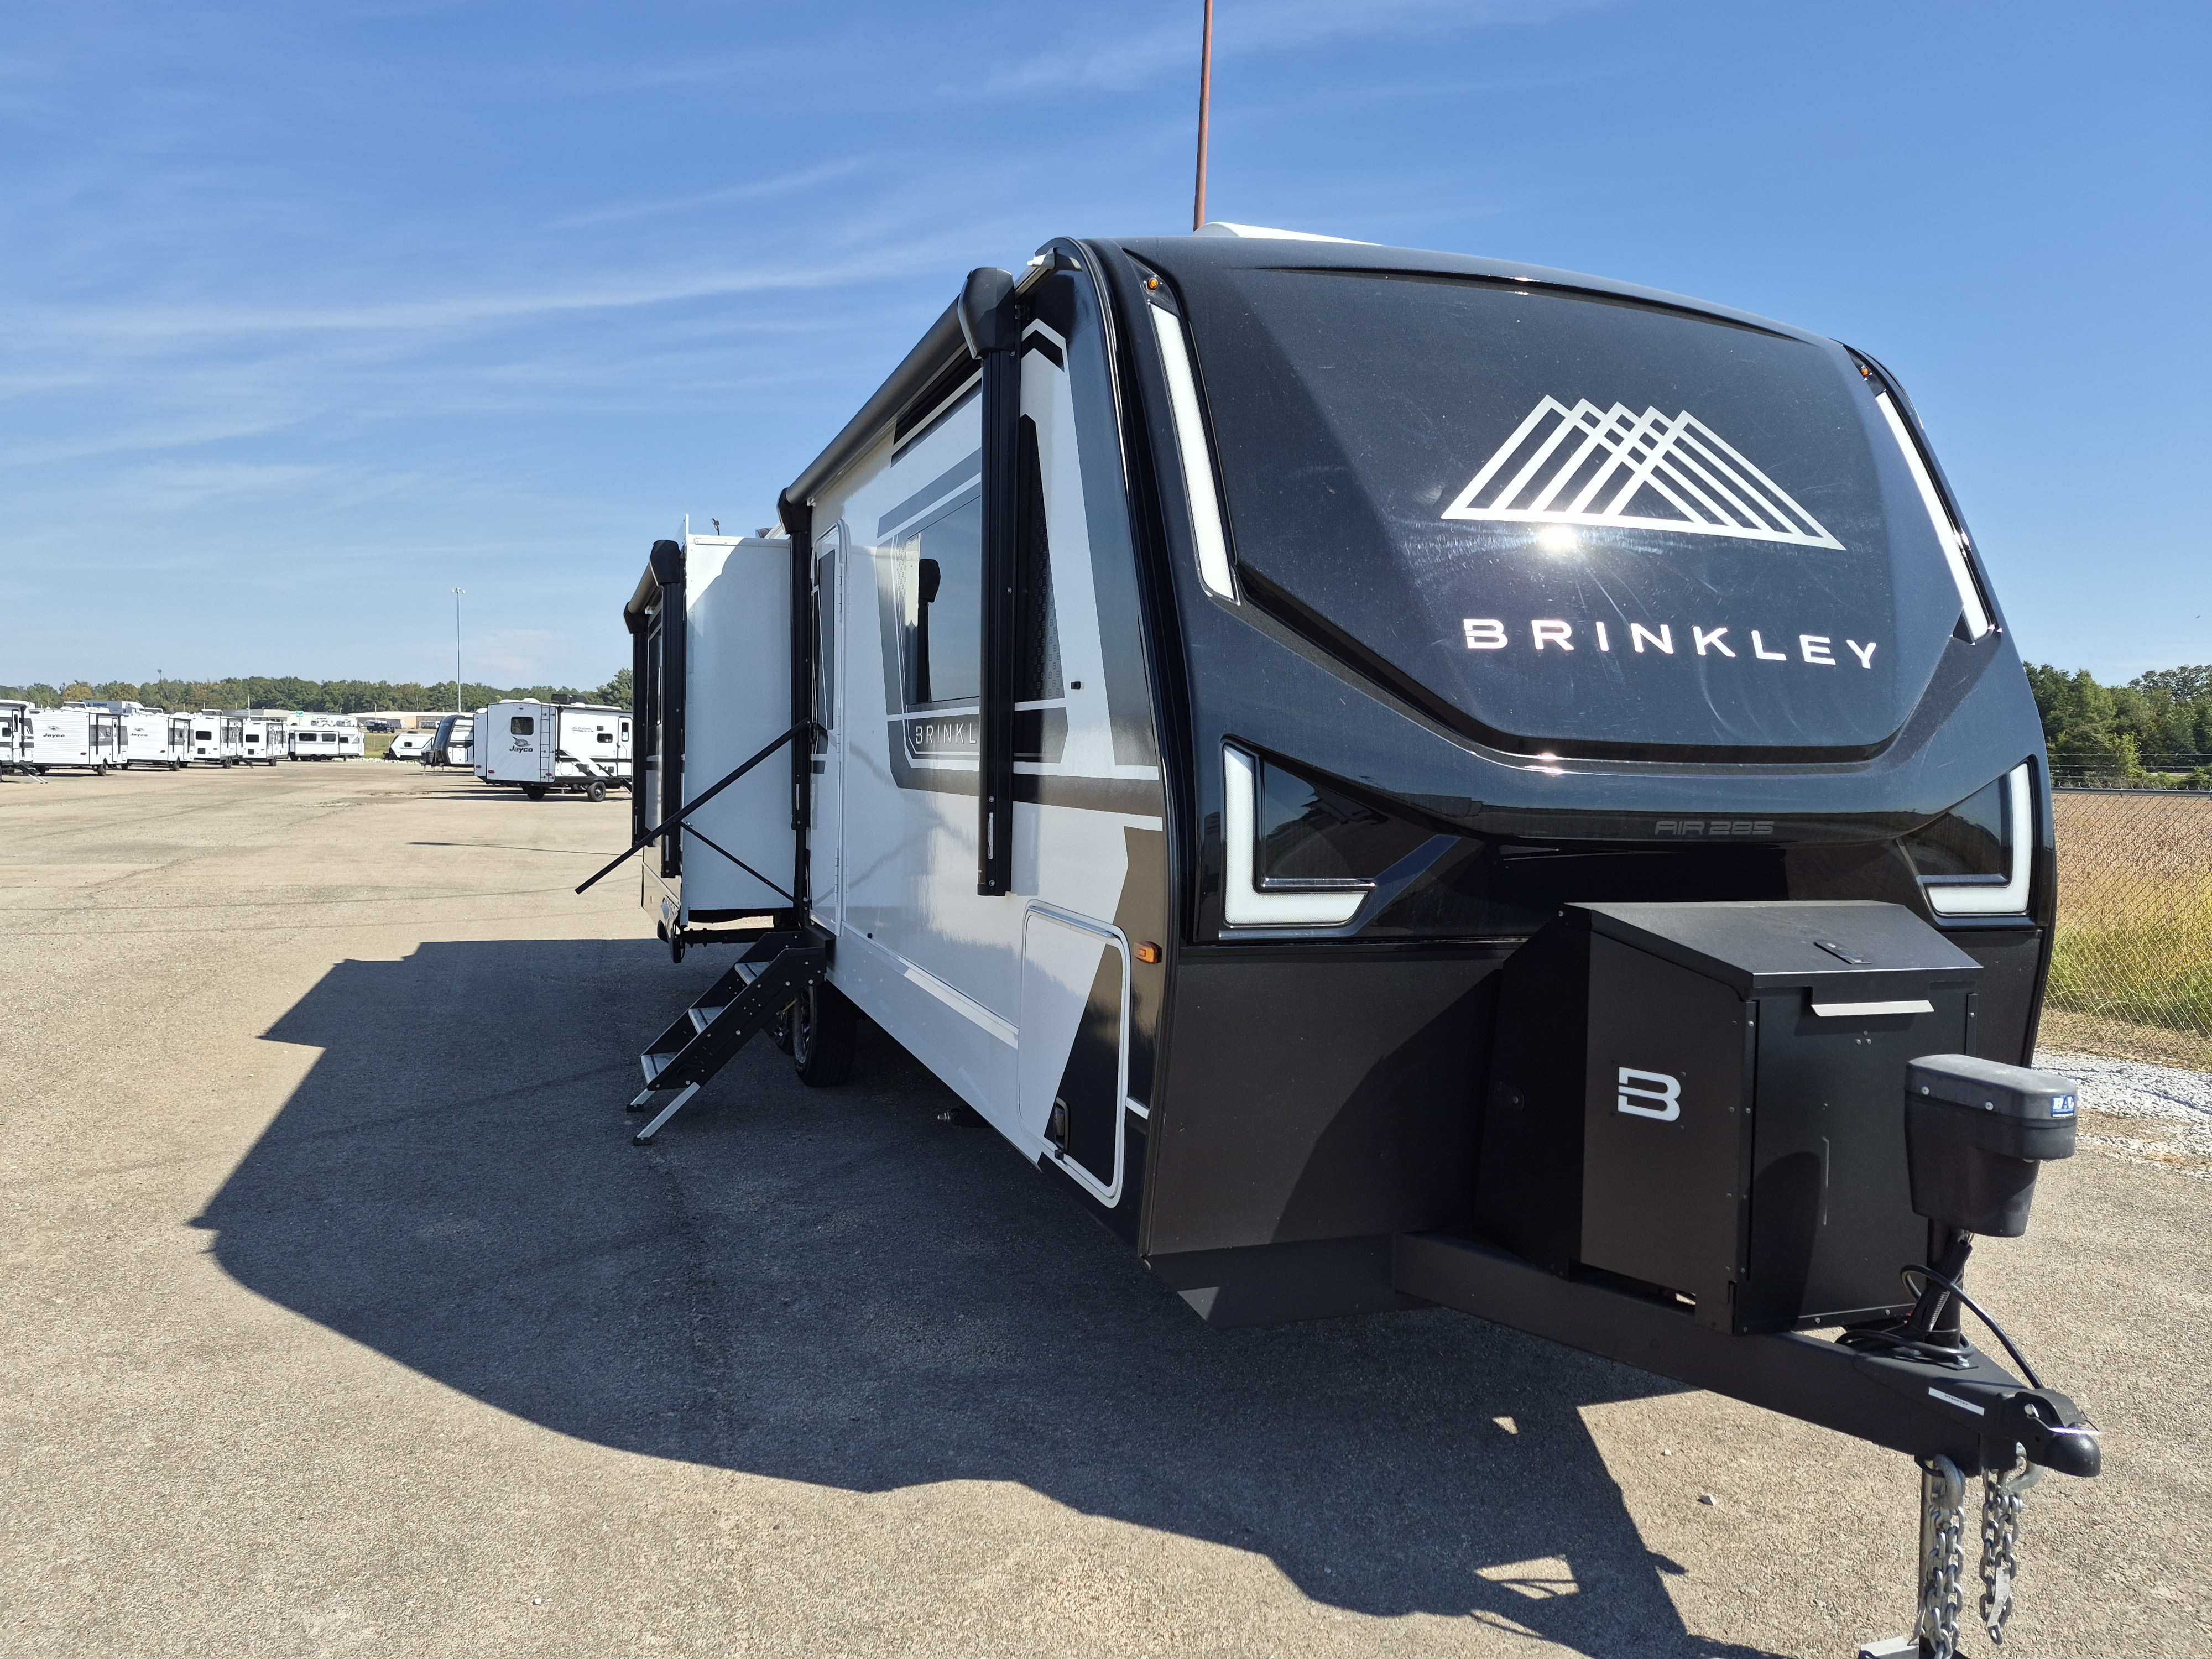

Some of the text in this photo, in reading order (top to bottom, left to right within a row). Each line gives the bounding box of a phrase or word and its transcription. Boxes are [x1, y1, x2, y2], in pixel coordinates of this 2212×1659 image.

[1463, 619, 1877, 669] BRINKLEY
[916, 722, 977, 744] BRINKL
[1655, 821, 1774, 835] AIR 285
[1618, 1067, 1681, 1121] B
